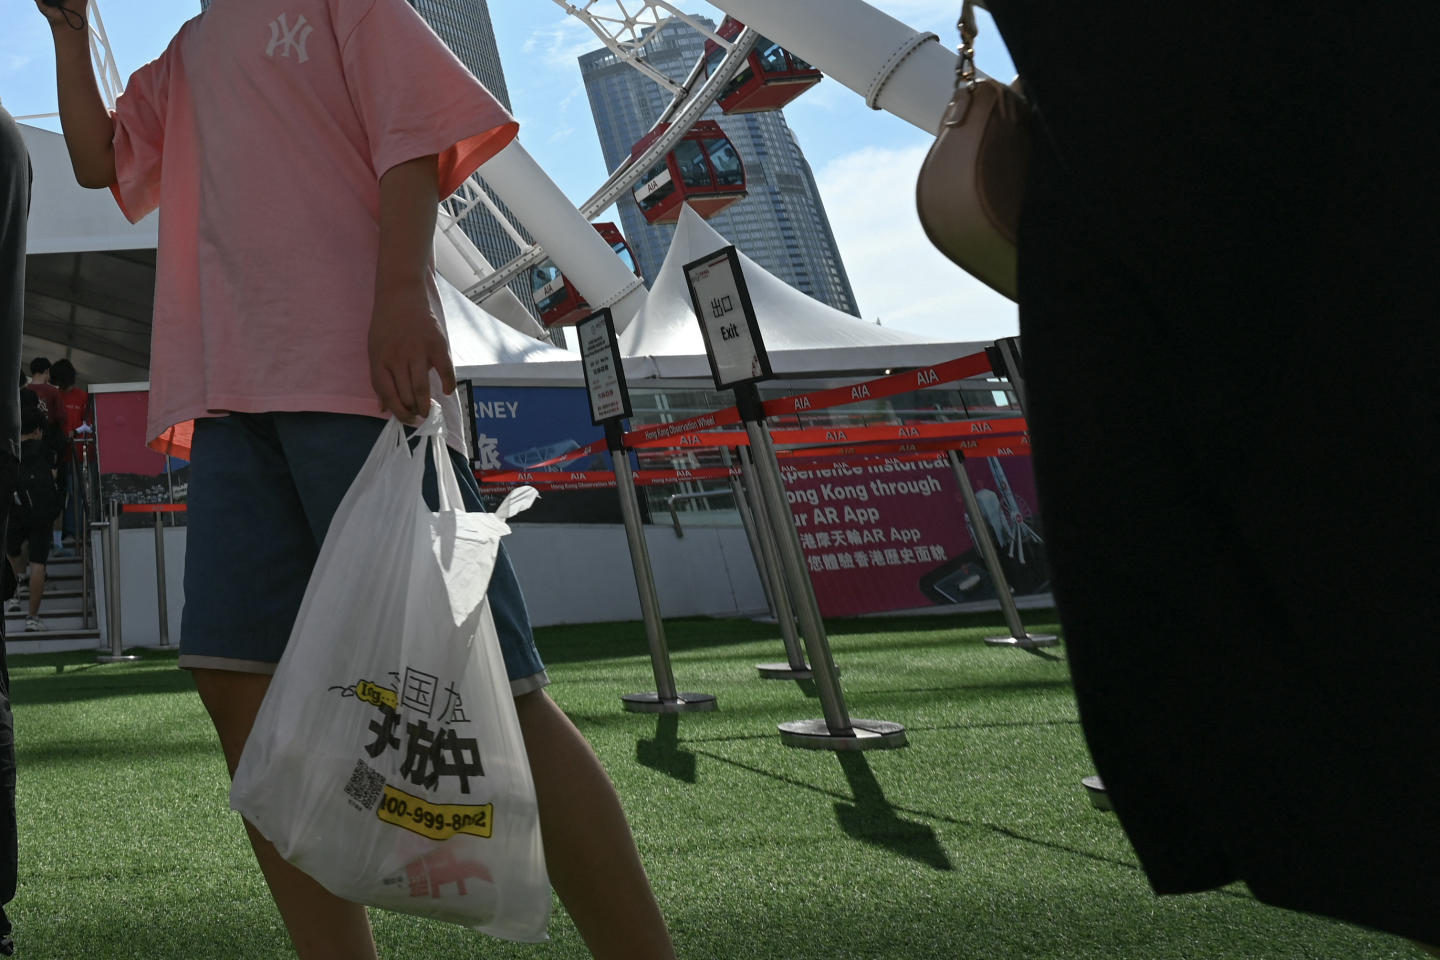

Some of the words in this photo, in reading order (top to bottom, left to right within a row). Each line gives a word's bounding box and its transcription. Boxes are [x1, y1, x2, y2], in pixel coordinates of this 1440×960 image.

[265, 12, 314, 64] NY
[647, 180, 659, 192] AIA
[544, 283, 554, 297] AIA
[710, 295, 734, 319] 出口
[720, 323, 740, 341] Exit
[794, 396, 811, 411] AIA
[851, 384, 871, 400] AIA
[917, 368, 940, 386] AIA
[696, 415, 716, 428] Wheel
[680, 435, 701, 445] AIA
[825, 430, 848, 441] AIA
[898, 427, 920, 438] AIA
[970, 422, 992, 433] AIA
[960, 440, 978, 449] AIA
[997, 447, 1015, 456] AIA
[517, 472, 535, 481] AIA
[570, 472, 587, 481] AIA
[676, 470, 692, 478] AIA
[786, 488, 820, 505] ong
[820, 483, 869, 502] Kong
[870, 474, 942, 497] through
[814, 506, 841, 526] AR
[844, 505, 881, 525] App
[890, 526, 922, 544] App
